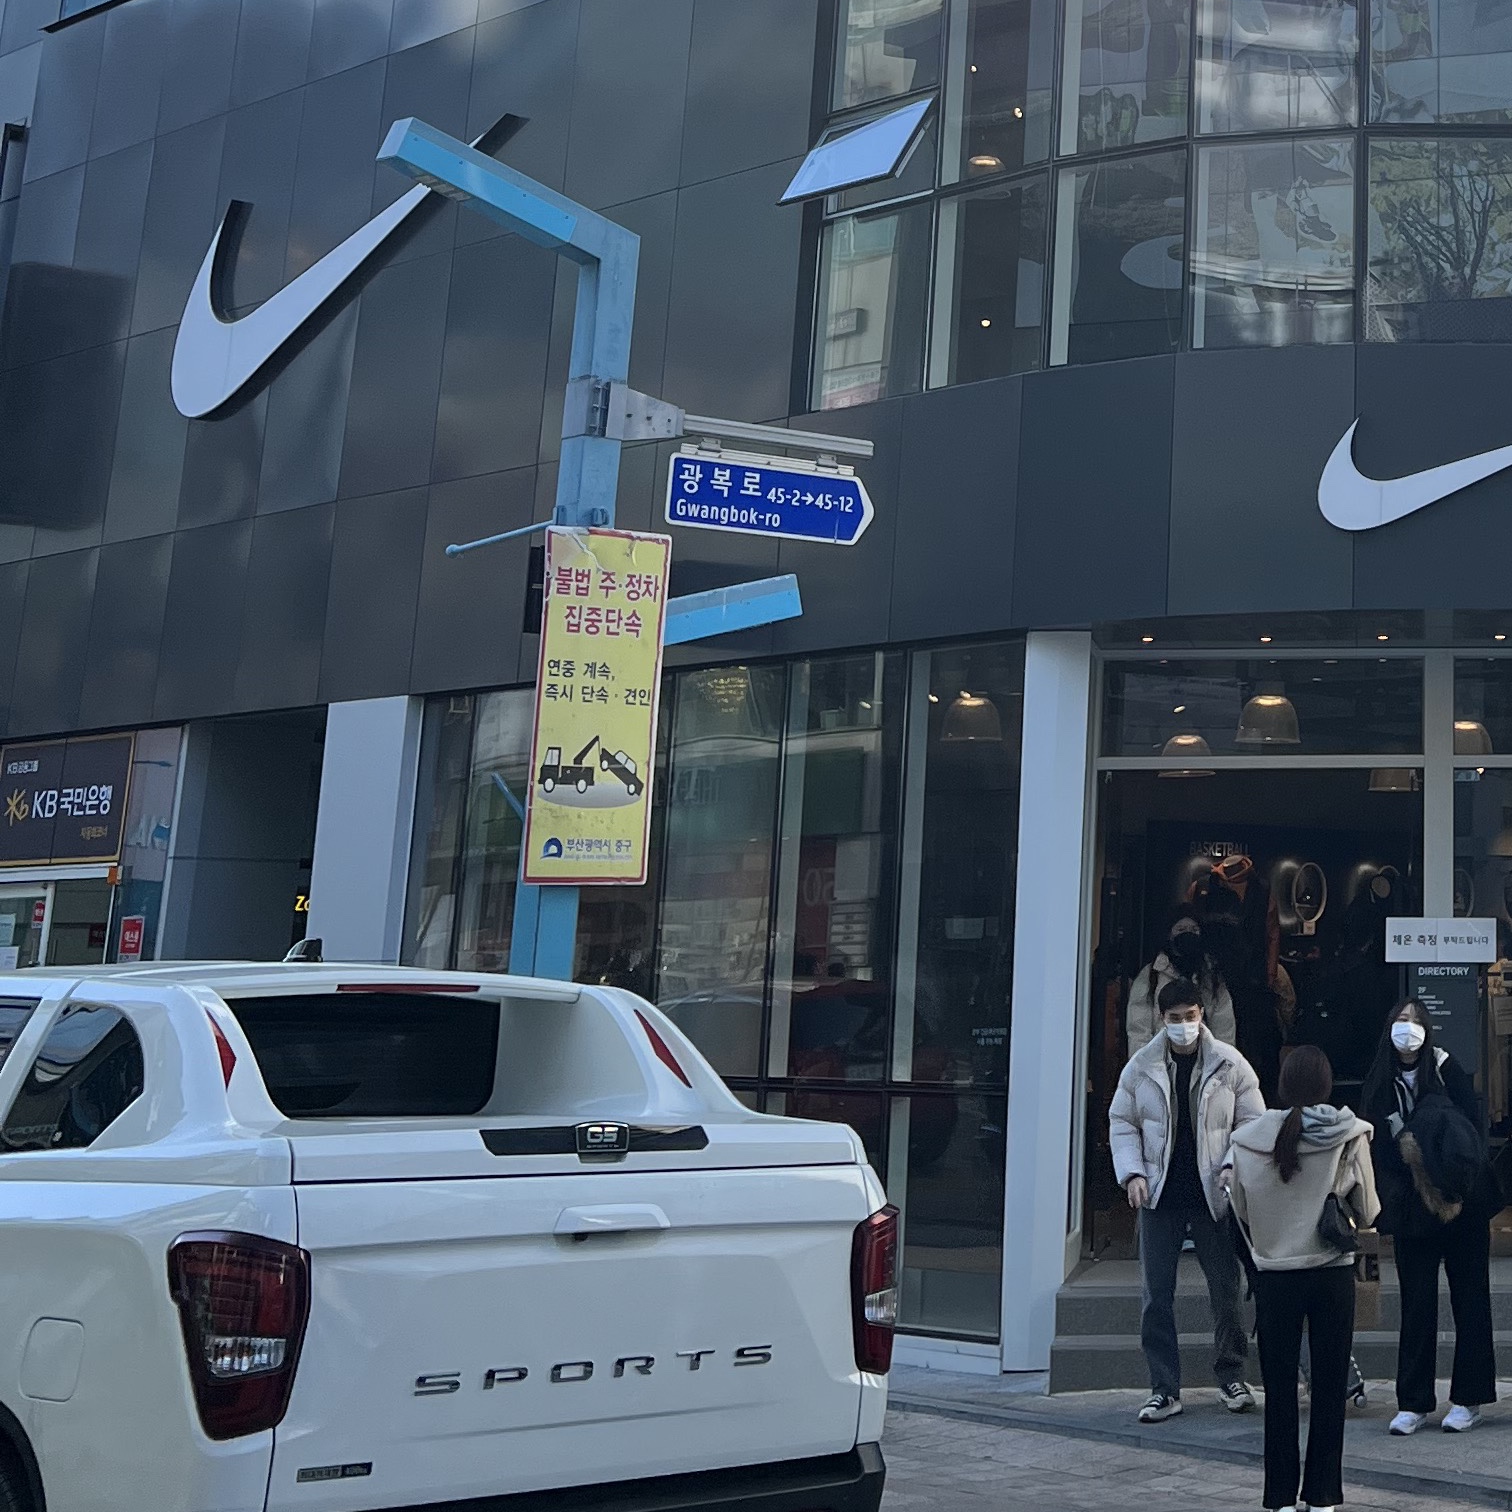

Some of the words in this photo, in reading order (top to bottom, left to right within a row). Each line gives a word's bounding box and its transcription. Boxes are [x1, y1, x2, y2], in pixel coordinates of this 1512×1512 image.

[676, 499, 781, 528] Gwangbok-ro
[554, 566, 592, 597] 불법
[564, 605, 642, 639] 집중단속
[547, 659, 576, 678] 연중
[545, 683, 574, 702] 즉시
[581, 686, 609, 704] 단속
[624, 688, 651, 707] 견인
[31, 784, 113, 819] KB국민은행
[566, 838, 611, 853] 부산광역시
[615, 839, 632, 852] 중구
[1392, 934, 1413, 946] 체온
[1417, 934, 1437, 946] 측정
[1418, 967, 1470, 976] DIRECTORY
[413, 1343, 773, 1397] SPORTS
